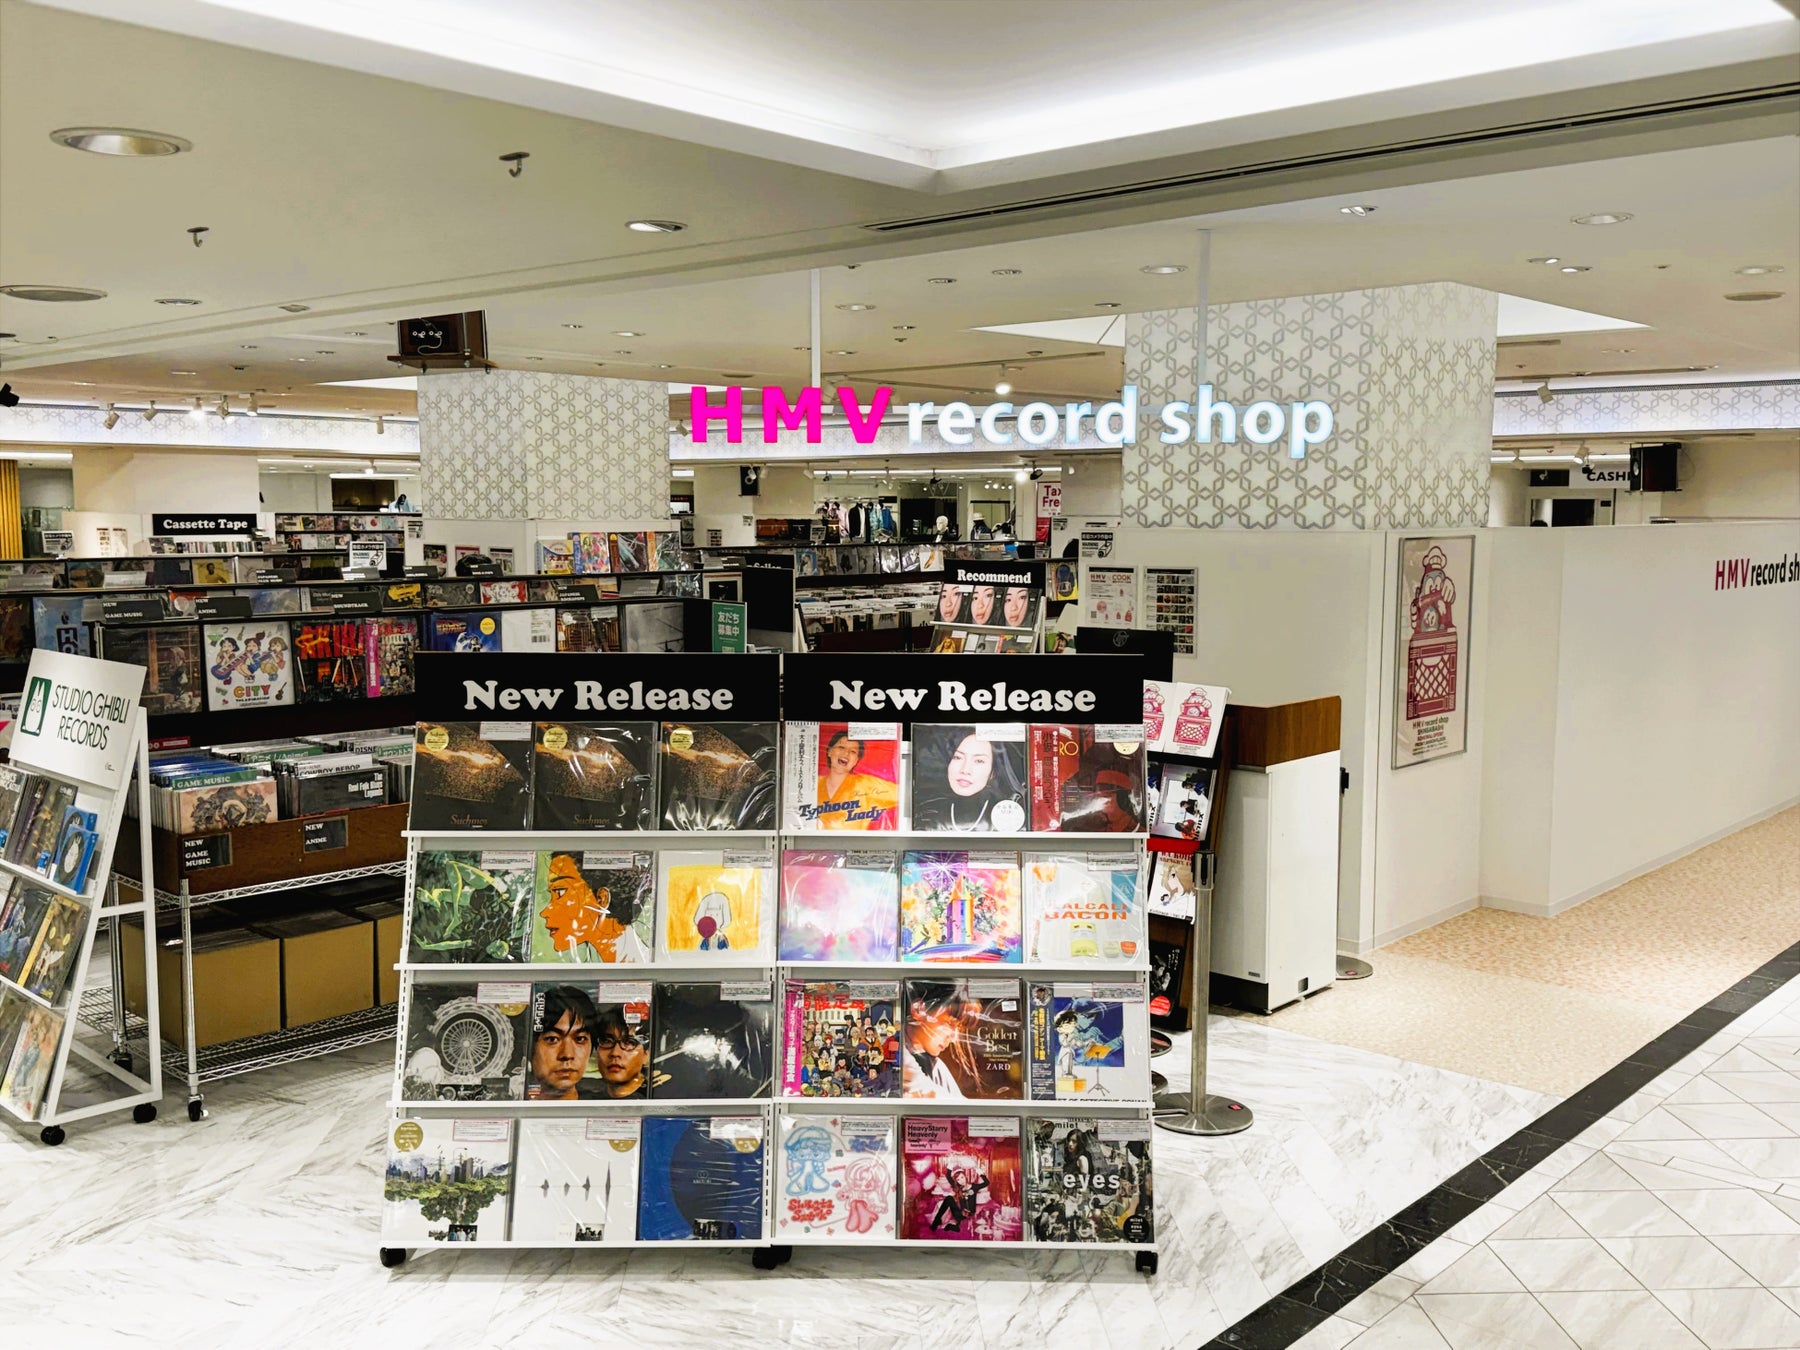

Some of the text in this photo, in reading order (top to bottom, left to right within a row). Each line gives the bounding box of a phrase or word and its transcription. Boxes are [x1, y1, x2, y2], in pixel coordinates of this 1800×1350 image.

[691, 384, 1334, 459] HMV record shop
[1042, 496, 1061, 507] Fre
[163, 518, 248, 531] Cassette Tape
[957, 569, 1032, 584] Recommend
[1715, 552, 1800, 591] HMV record sh
[717, 611, 741, 624] 友だち
[233, 684, 271, 699] CITY
[462, 680, 734, 711] New Release
[829, 680, 1097, 712] New Release
[52, 684, 131, 725] STUDIO GHIBLI
[57, 715, 110, 751] RECORDS
[177, 776, 231, 788] GAME MUSIC
[799, 799, 861, 821] Typhoon
[845, 806, 887, 822] Lady
[451, 814, 488, 825] Suchmos
[304, 823, 324, 831] NEW
[185, 839, 204, 848] NEW
[305, 836, 327, 845] ANIME
[185, 850, 208, 859] GAME
[185, 858, 211, 867] MUSIC
[977, 1026, 1017, 1040] Golden
[984, 1040, 1010, 1053] Best
[986, 1063, 1011, 1071] ZARD
[1063, 1173, 1120, 1191] eyes
